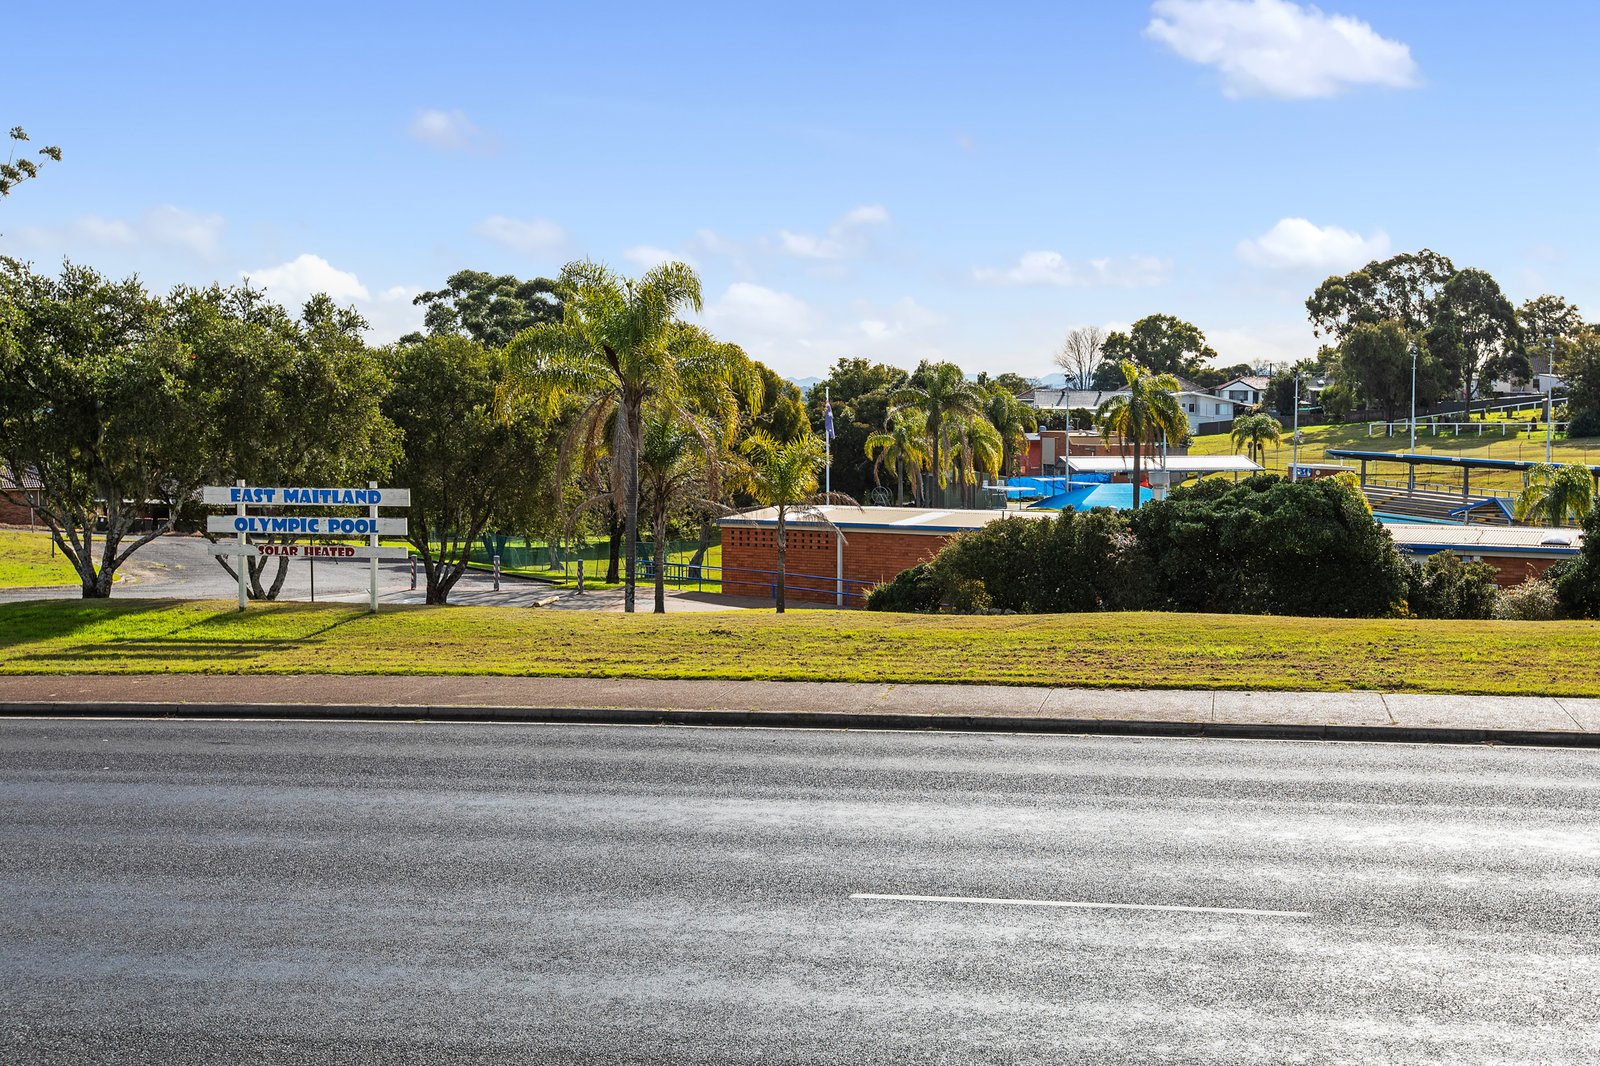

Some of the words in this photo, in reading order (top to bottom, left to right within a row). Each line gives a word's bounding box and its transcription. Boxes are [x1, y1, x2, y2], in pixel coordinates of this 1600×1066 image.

[230, 488, 276, 503] EAST
[283, 489, 382, 504] MAITLAND
[234, 517, 319, 533] OLYMPIC
[328, 518, 379, 533] POOL
[258, 545, 299, 556] SOLAR
[304, 546, 355, 557] HEATED
